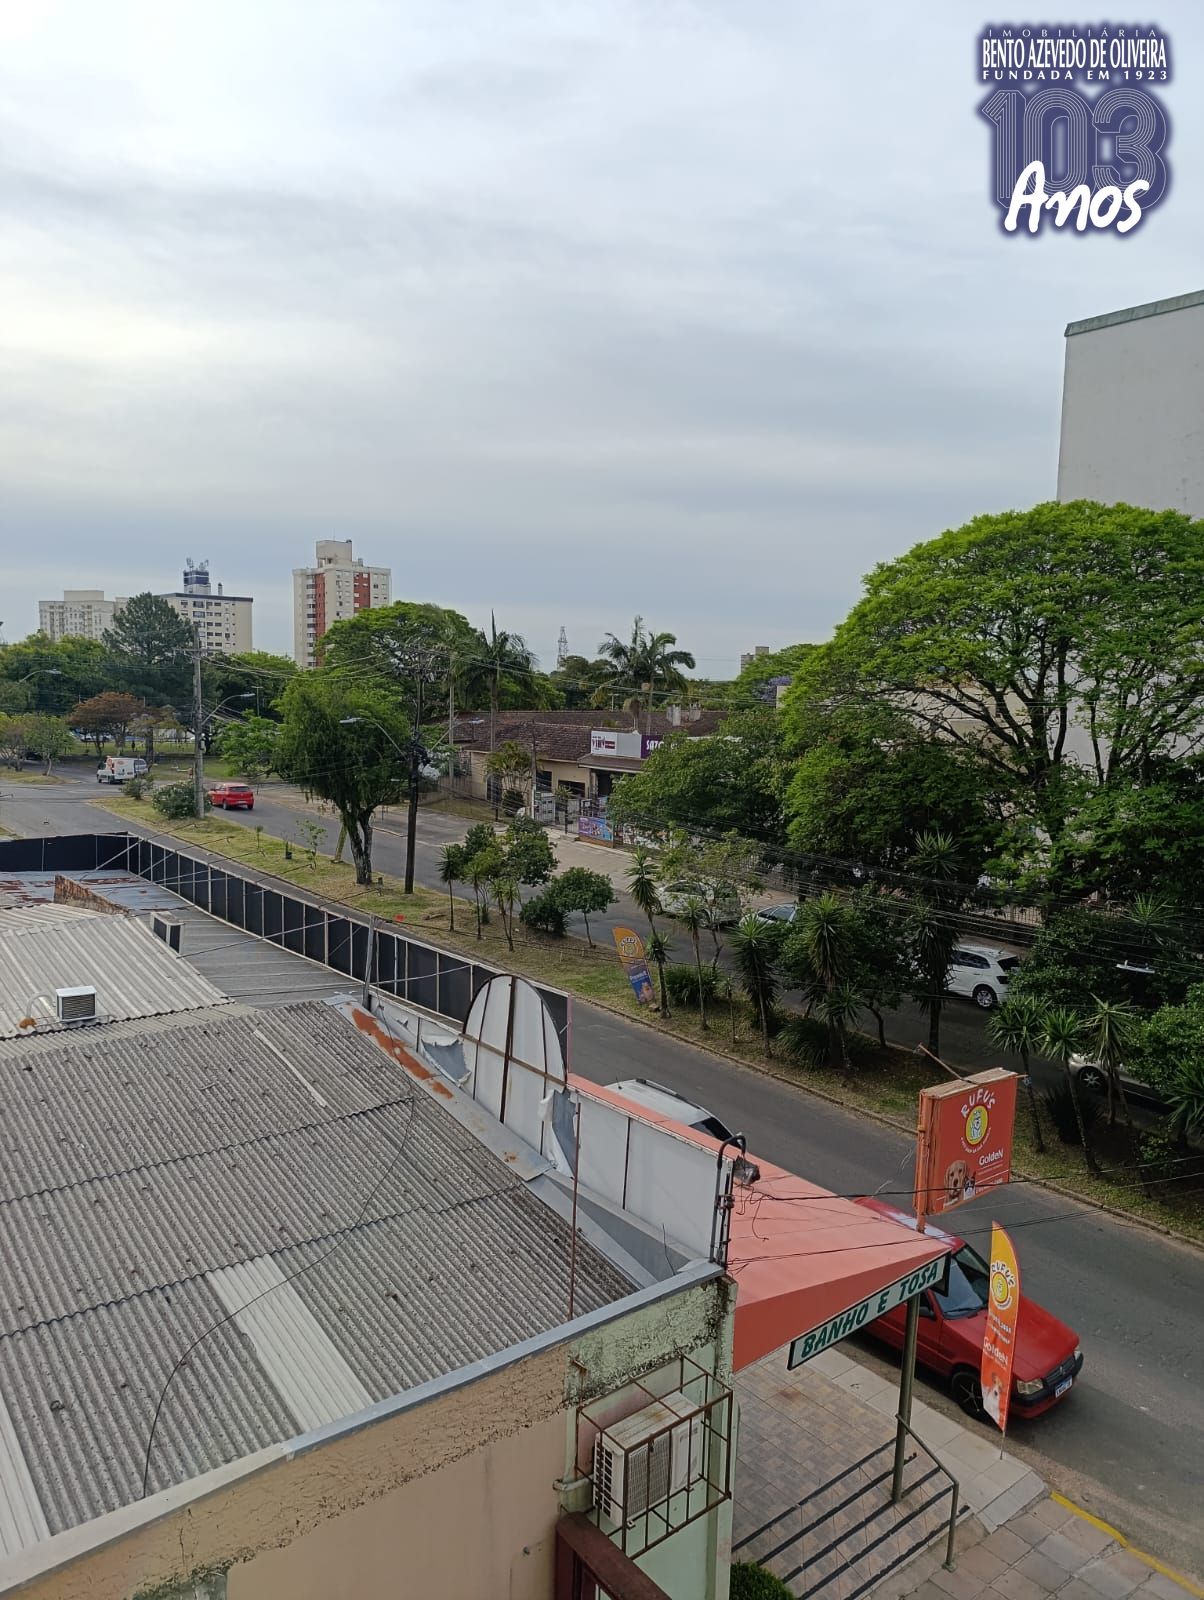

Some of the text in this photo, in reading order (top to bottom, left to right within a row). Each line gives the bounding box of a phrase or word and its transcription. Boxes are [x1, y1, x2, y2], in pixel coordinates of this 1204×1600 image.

[800, 1262, 939, 1358] BANHO E TOSA
